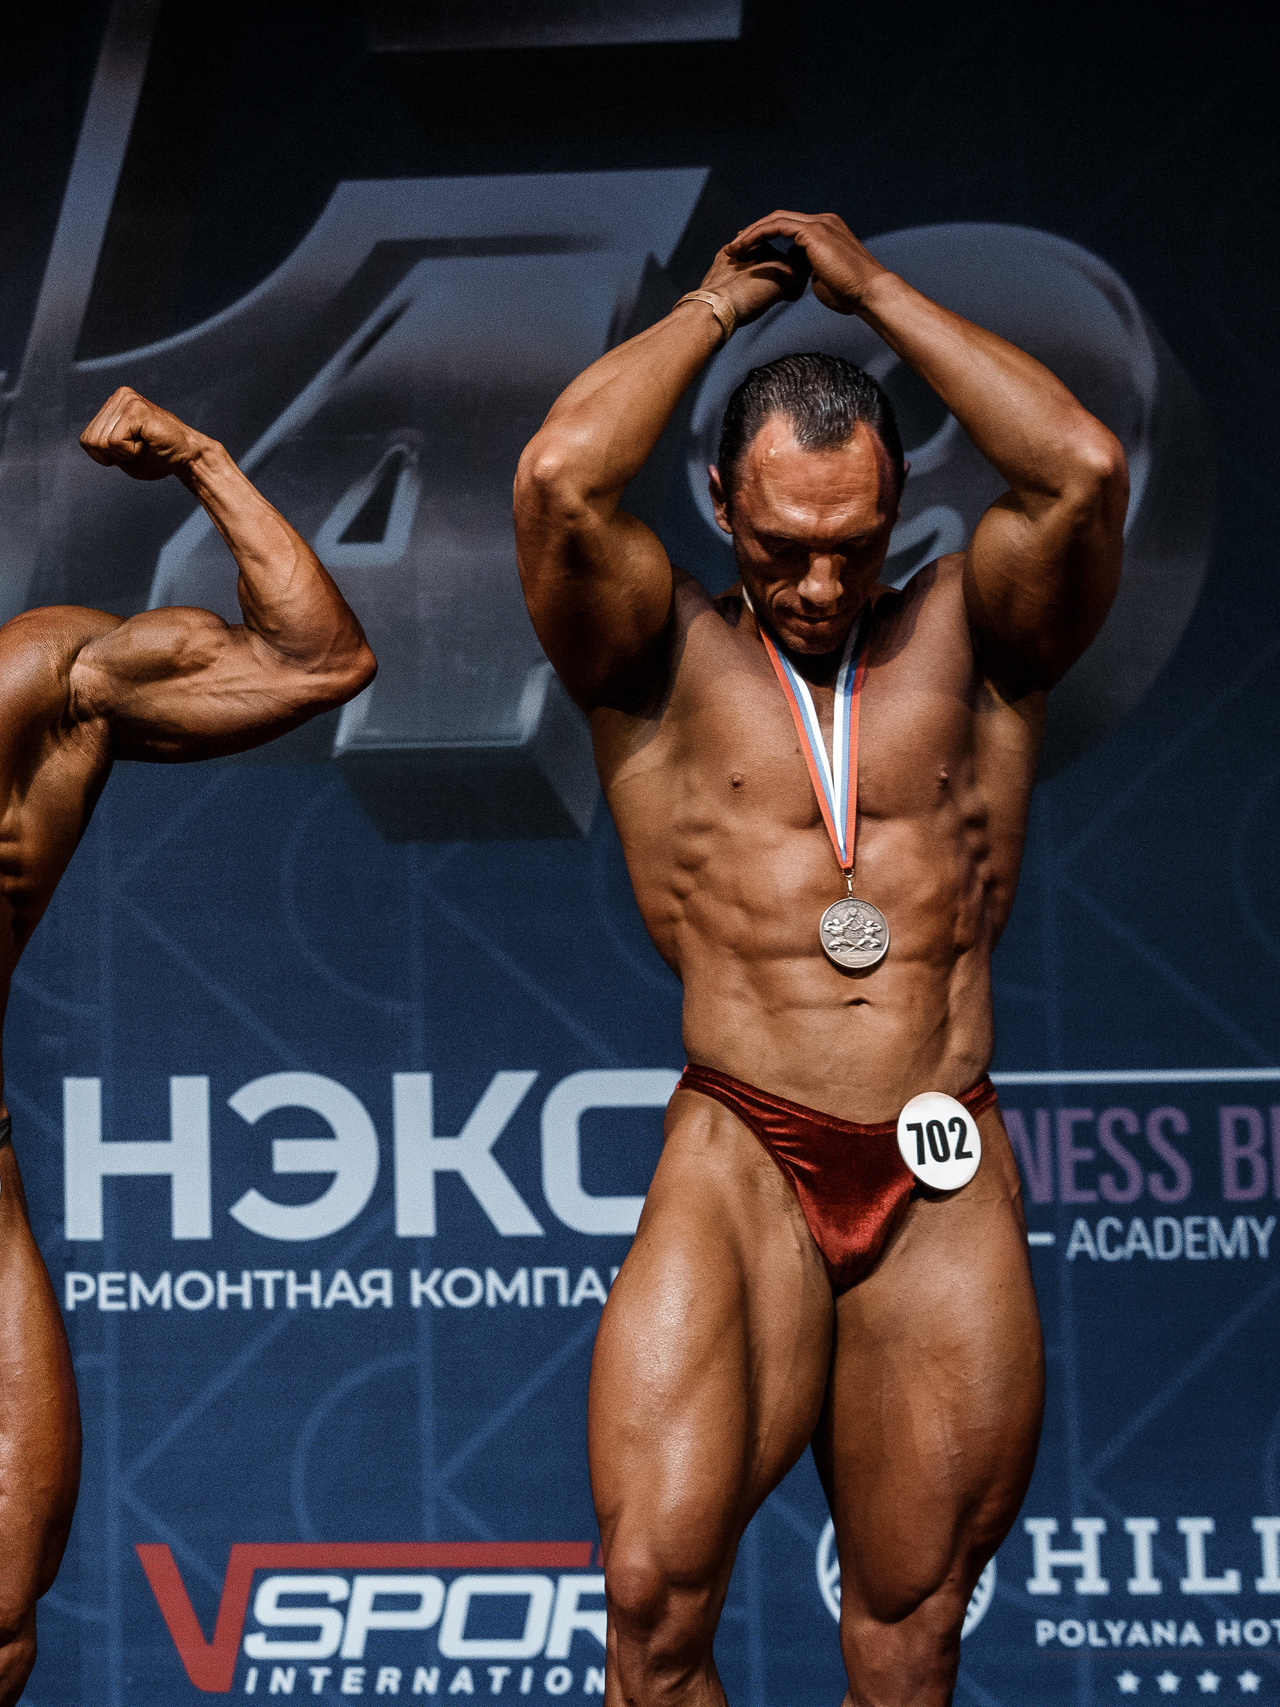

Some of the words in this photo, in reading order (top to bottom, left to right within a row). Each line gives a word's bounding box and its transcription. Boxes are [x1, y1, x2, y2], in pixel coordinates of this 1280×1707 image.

[906, 1116, 973, 1166] 702
[1066, 1215, 1278, 1262] ACADEMY
[65, 1269, 393, 1311] РЕМОНТНАЯ
[409, 1266, 620, 1309] КОМПА
[1034, 1618, 1205, 1648] POLYANA
